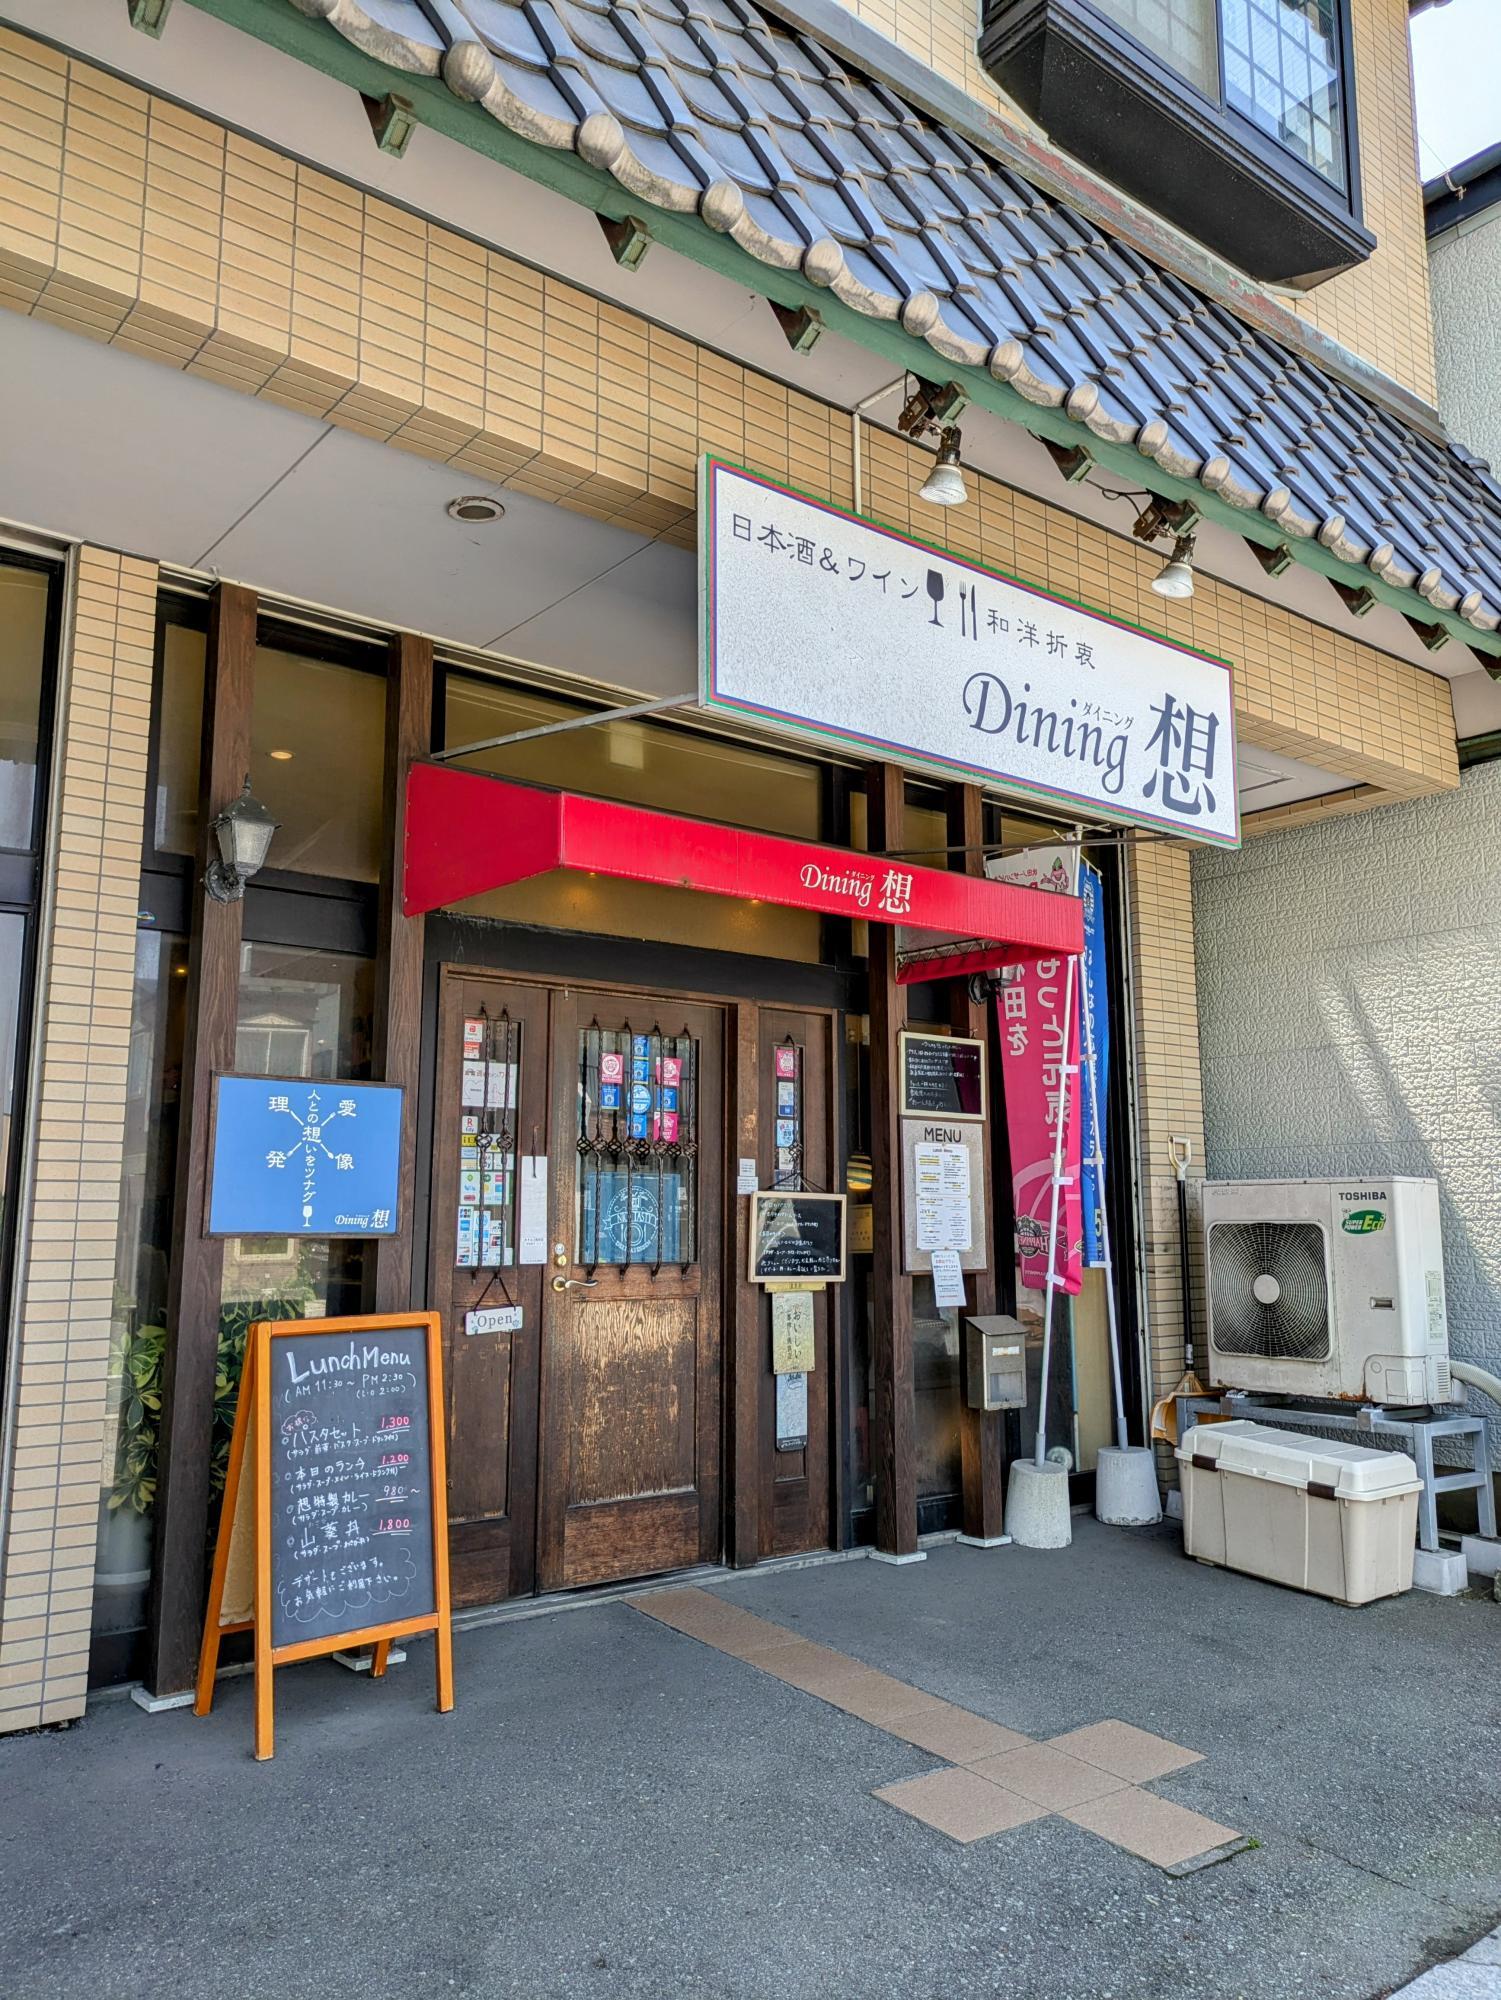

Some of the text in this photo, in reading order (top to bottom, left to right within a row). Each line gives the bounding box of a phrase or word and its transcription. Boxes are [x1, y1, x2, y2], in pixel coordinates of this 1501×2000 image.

[986, 607, 1097, 670] 和洋折衷
[1081, 700, 1135, 731] ダイニング
[962, 672, 1220, 816] Dining 想
[800, 864, 913, 913] Dining 想
[268, 1096, 290, 1113] 理
[338, 1099, 357, 1117] 愛
[924, 1127, 962, 1143] MENU
[266, 1150, 287, 1169] 発
[334, 1152, 355, 1171] 像
[1338, 1191, 1387, 1201] TOSHIBA
[334, 1208, 390, 1229] Dining 想
[477, 1315, 513, 1329] Open
[295, 1456, 366, 1481] 本日のランチ
[384, 1485, 405, 1497] 980
